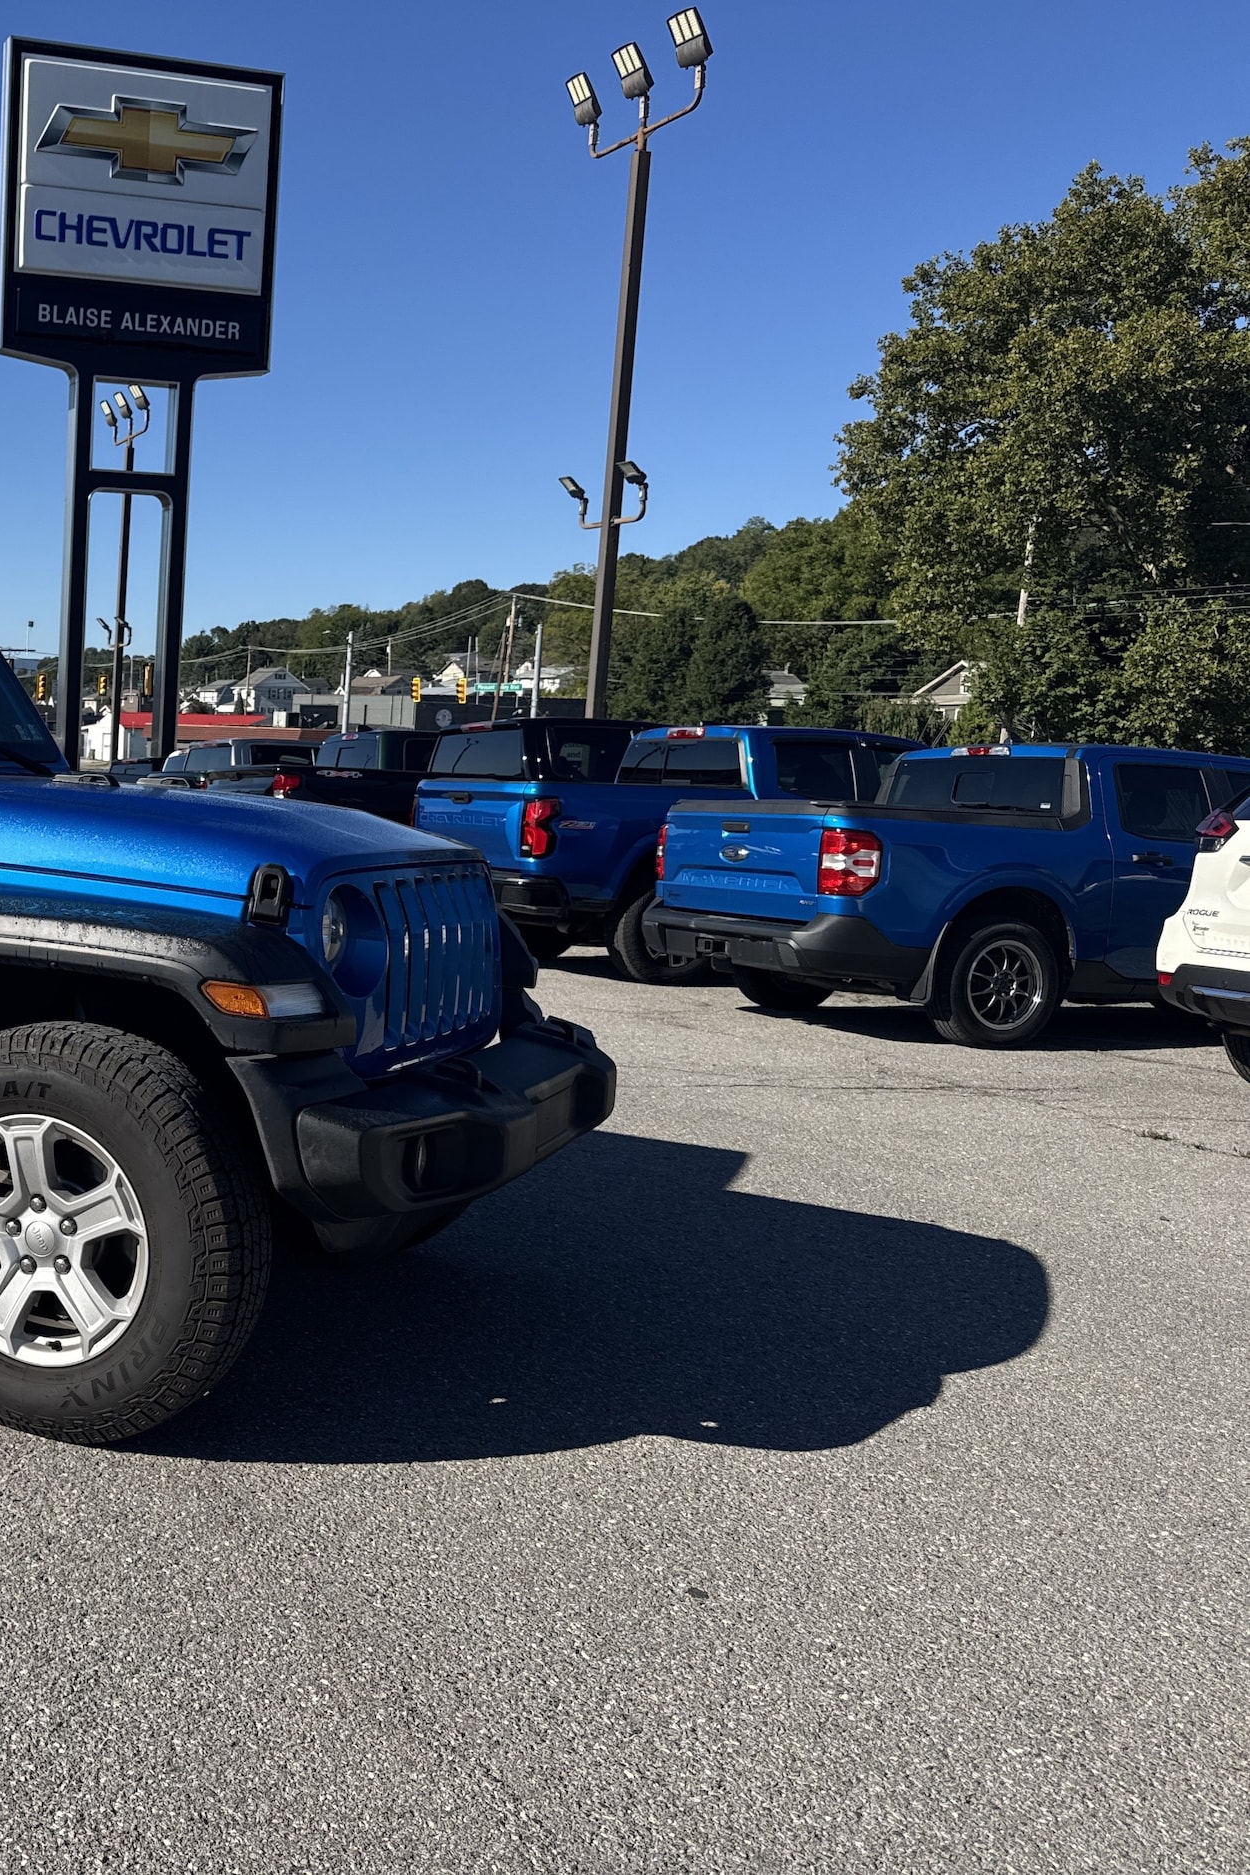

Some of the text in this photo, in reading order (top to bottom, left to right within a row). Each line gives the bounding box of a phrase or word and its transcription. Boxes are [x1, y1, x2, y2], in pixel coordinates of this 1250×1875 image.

[34, 208, 252, 261] CHEVROLET
[37, 303, 241, 340] BLAISE ALEXANDER
[419, 812, 500, 826] CHEVROLET
[1186, 908, 1220, 917] ROGUE
[3, 1080, 52, 1099] A/T
